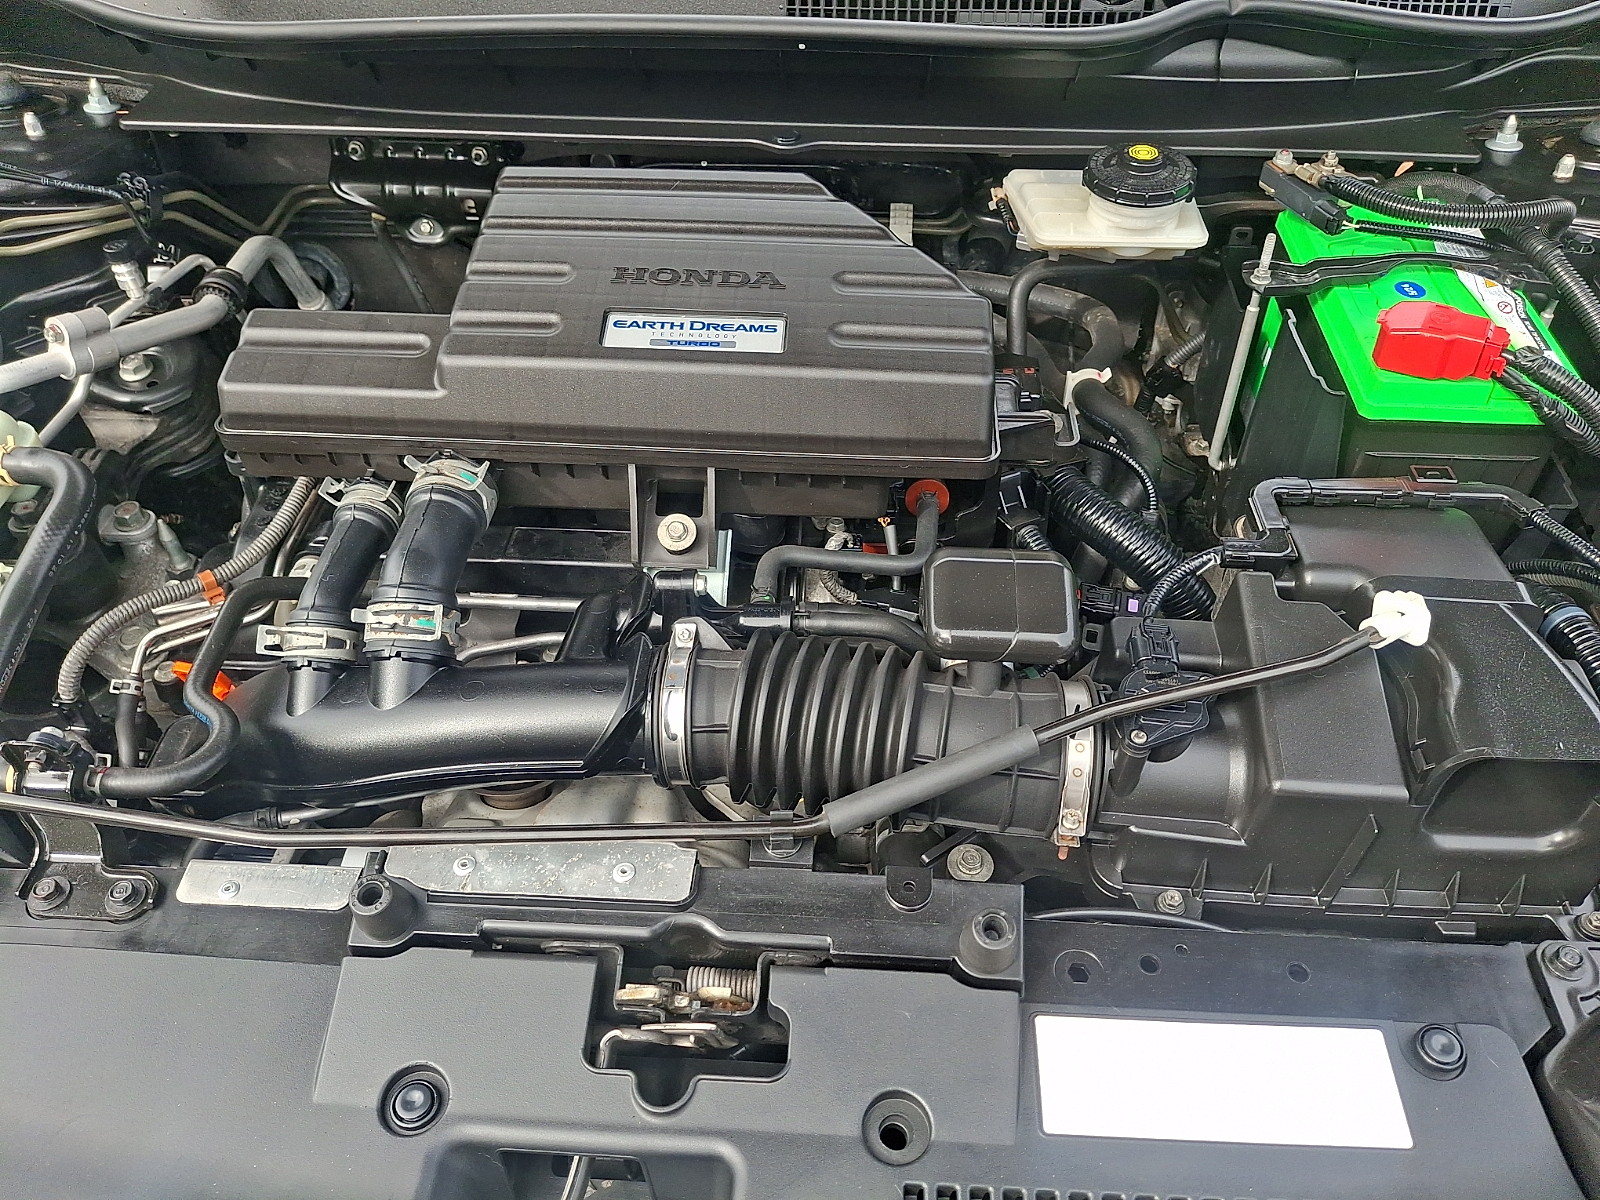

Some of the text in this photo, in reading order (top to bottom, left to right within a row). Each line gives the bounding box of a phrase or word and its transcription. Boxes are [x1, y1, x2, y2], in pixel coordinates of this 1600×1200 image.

[610, 267, 786, 289] HONDA
[612, 319, 778, 333] EARTH DREAMS
[651, 331, 737, 339] TECHNOLOGY
[666, 339, 721, 347] TURBO
